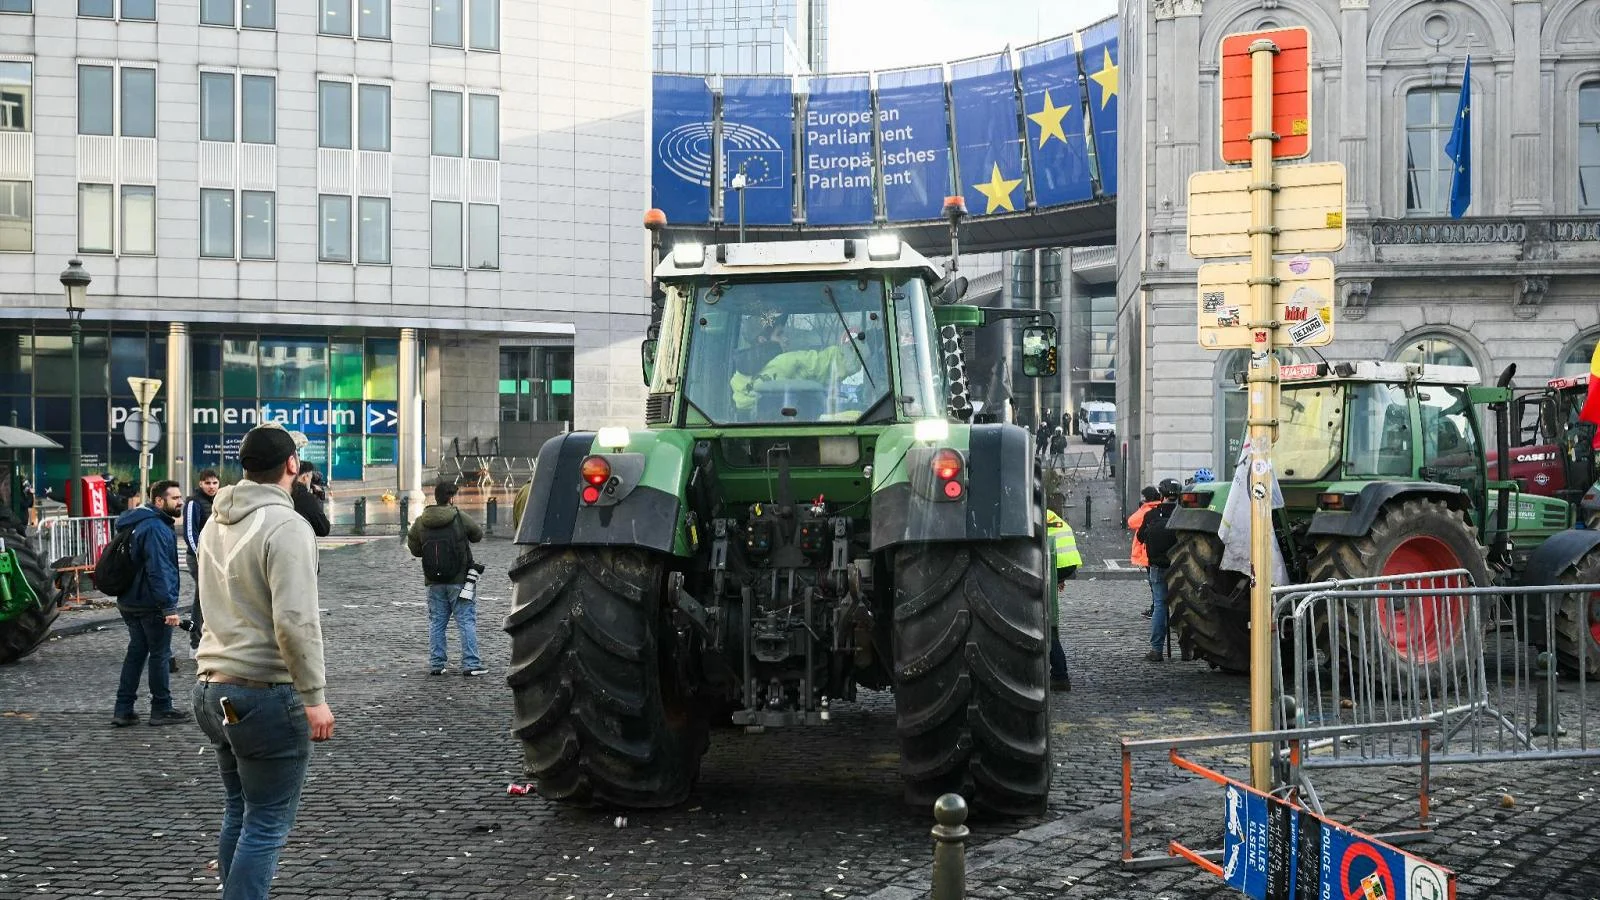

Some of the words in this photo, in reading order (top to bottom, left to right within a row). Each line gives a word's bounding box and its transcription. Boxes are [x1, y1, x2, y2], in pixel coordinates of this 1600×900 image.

[807, 109, 899, 127] European
[808, 147, 936, 170] Europäisches
[809, 170, 912, 189] Parlament
[1517, 453, 1545, 462] CASE
[1249, 821, 1257, 866] ELSENE
[1258, 823, 1266, 873] IXELLES
[1323, 827, 1331, 875] POLICE
